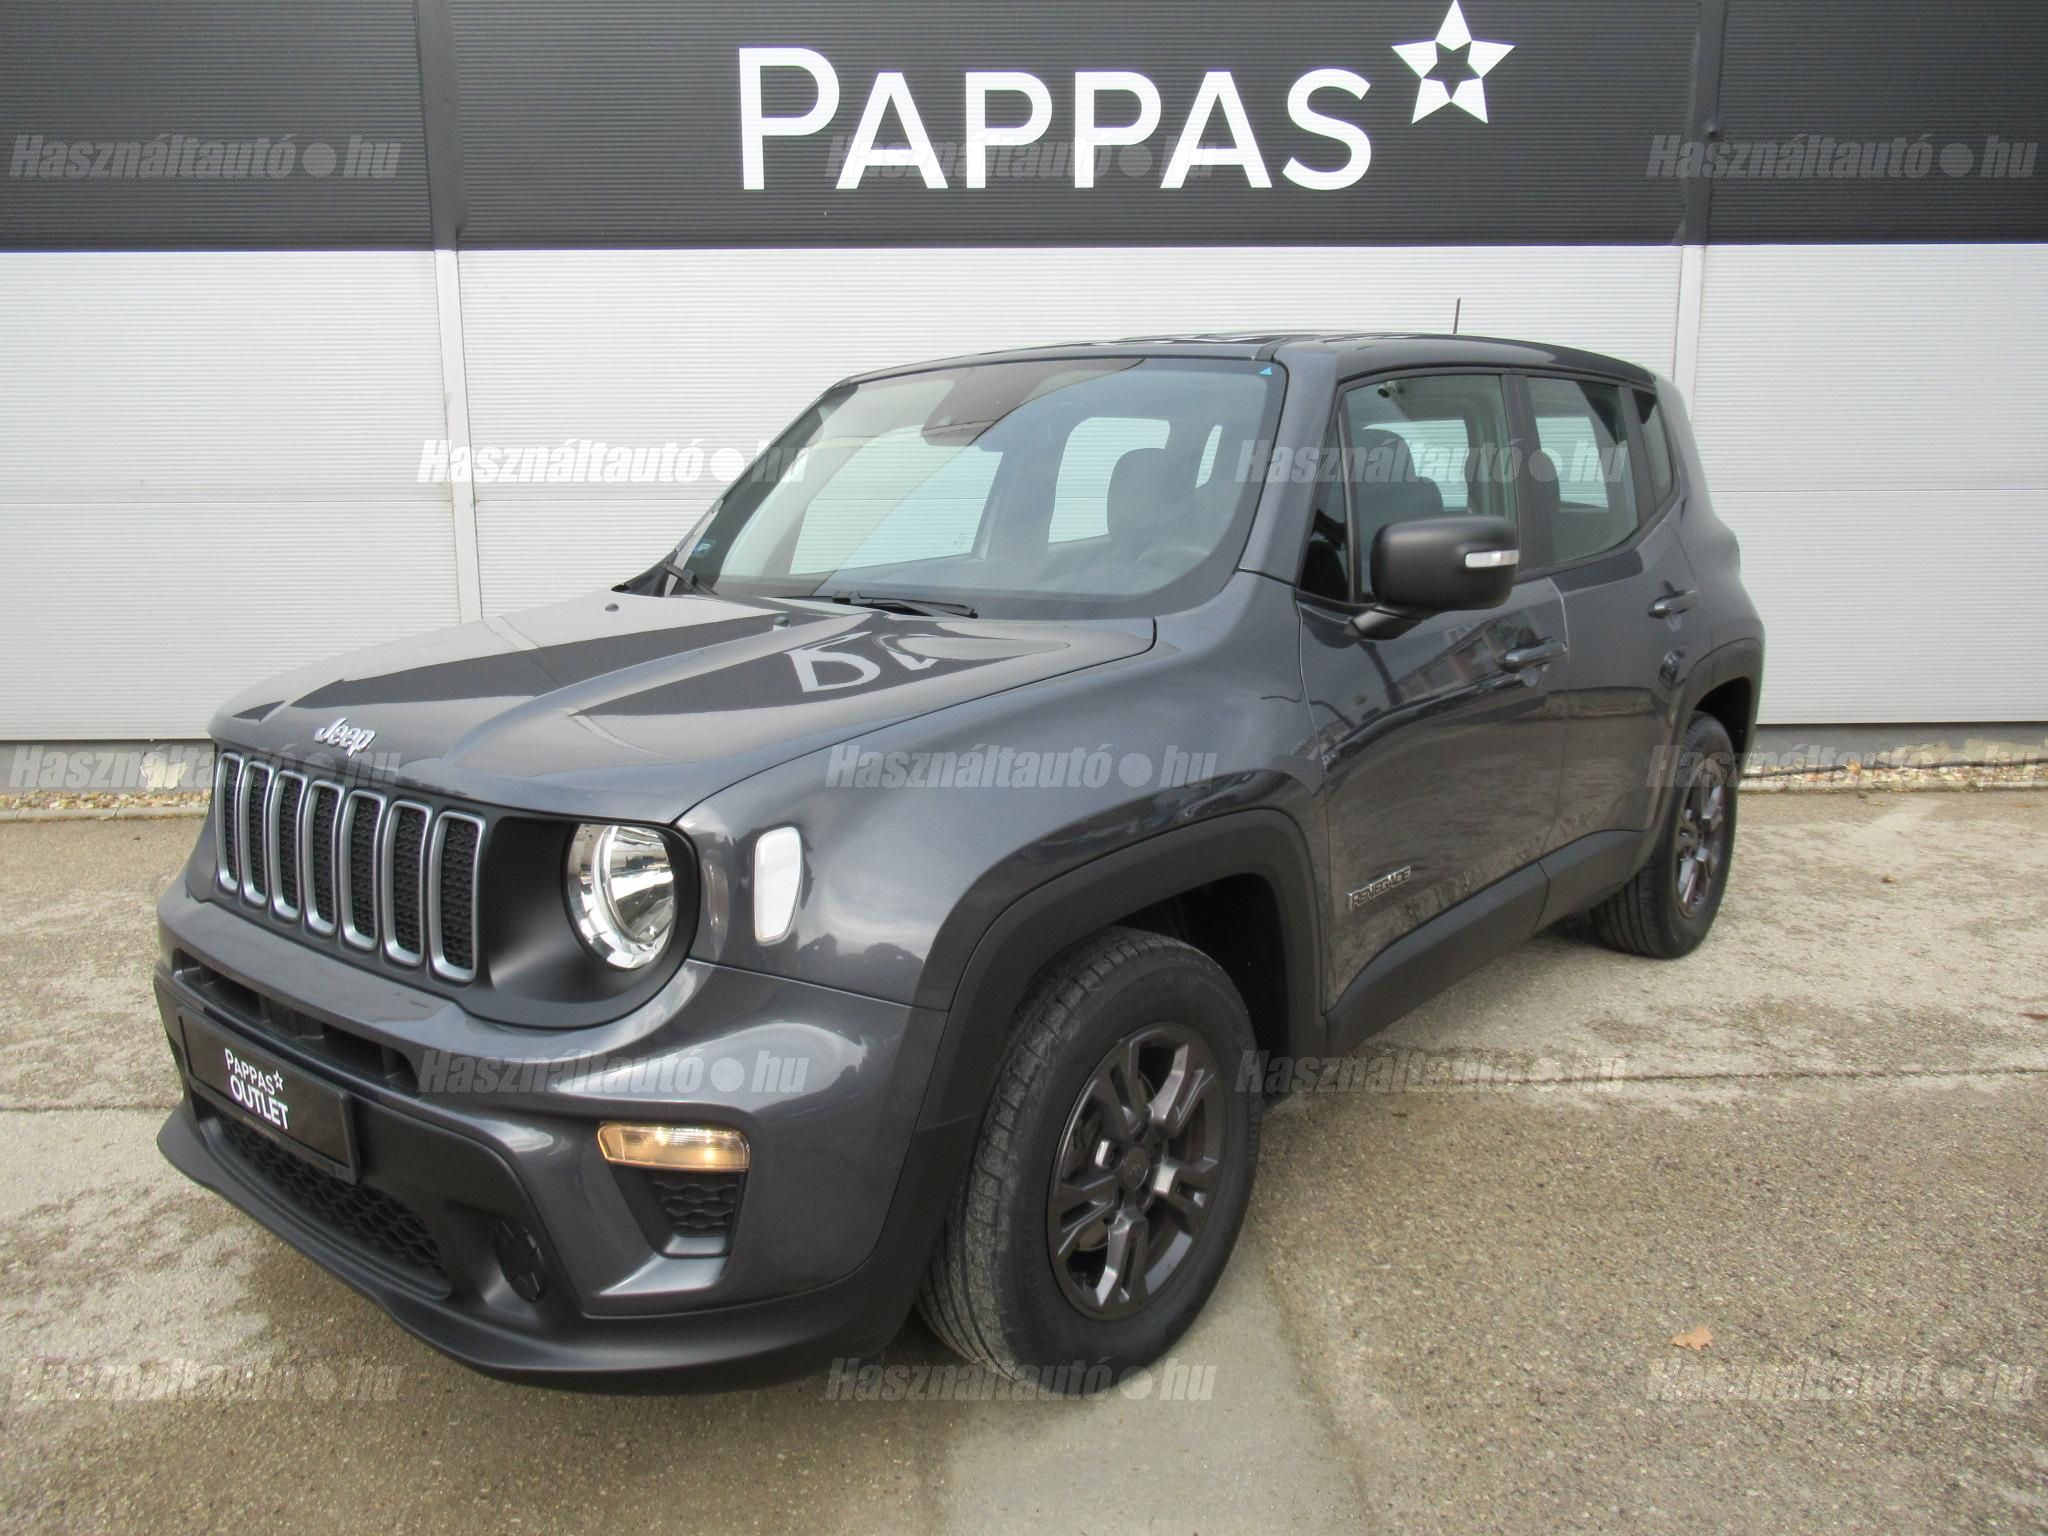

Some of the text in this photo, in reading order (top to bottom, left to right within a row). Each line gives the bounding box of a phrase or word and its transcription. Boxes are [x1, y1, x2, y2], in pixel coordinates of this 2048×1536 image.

[314, 717, 376, 759] Jeep
[224, 1048, 275, 1095] PAPPAS
[230, 1074, 288, 1130] OUTLET
